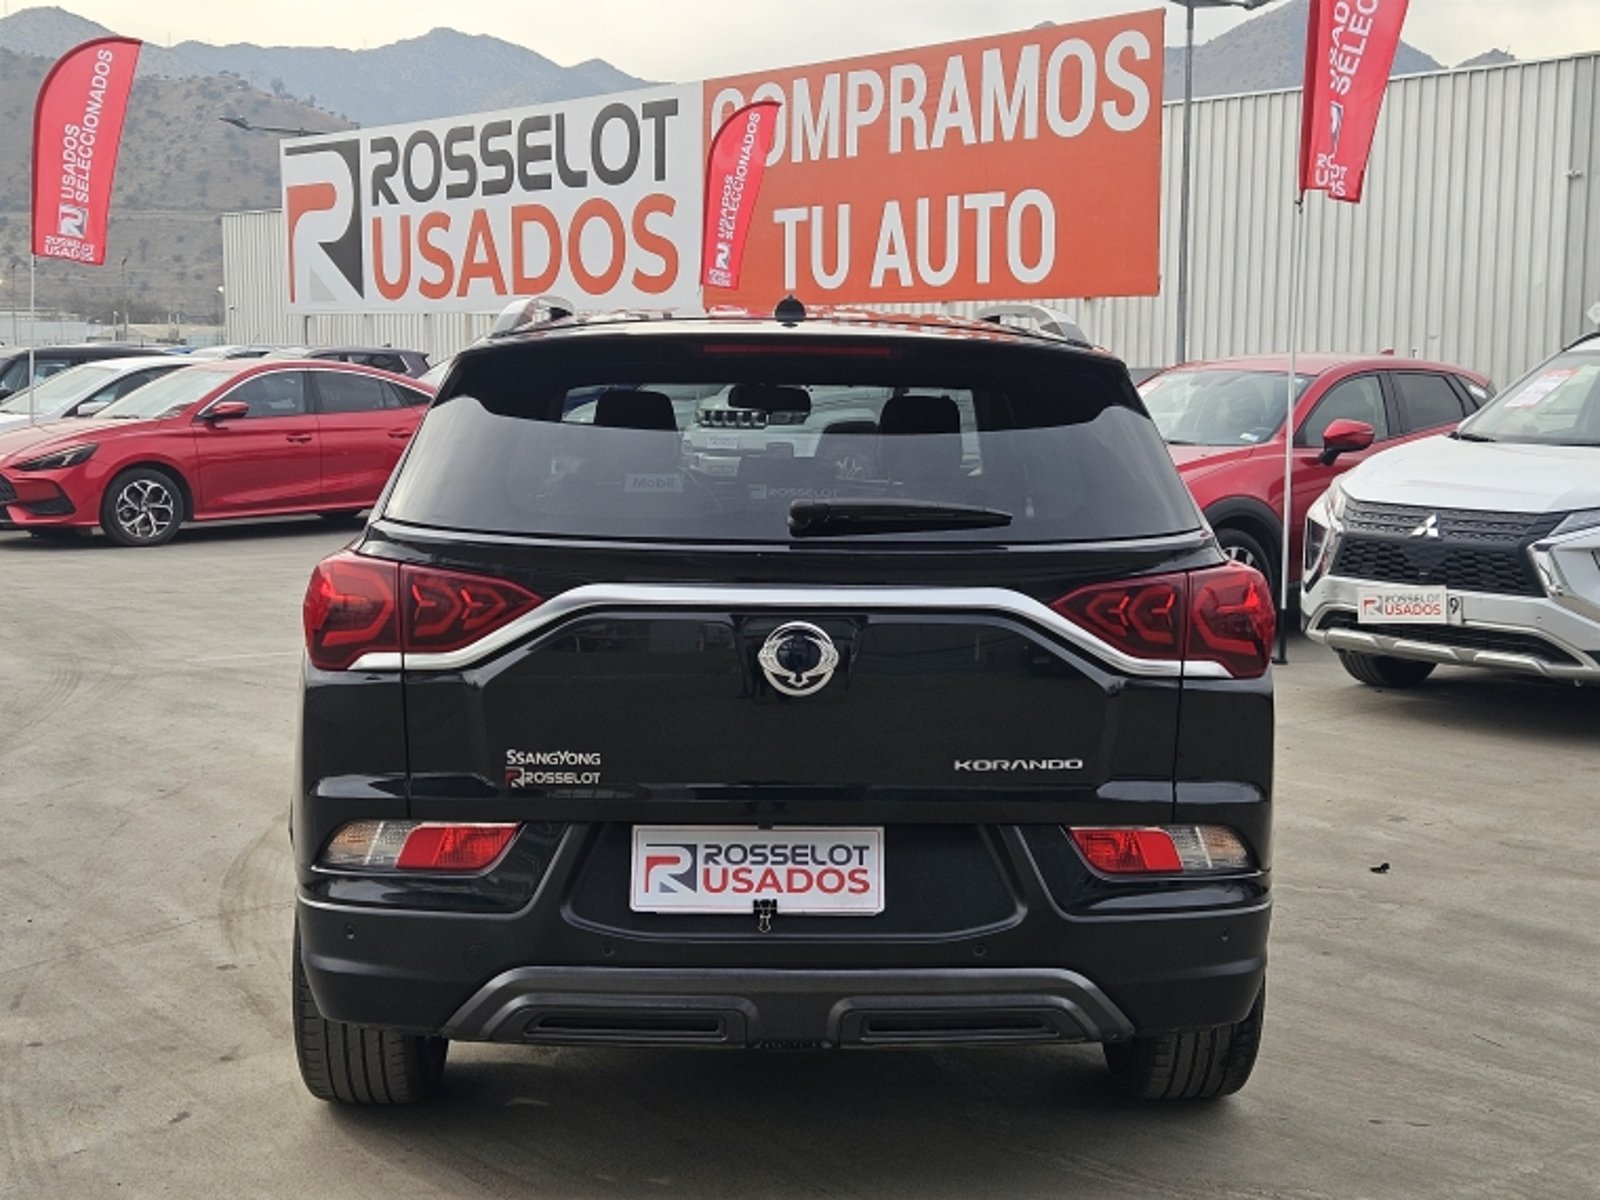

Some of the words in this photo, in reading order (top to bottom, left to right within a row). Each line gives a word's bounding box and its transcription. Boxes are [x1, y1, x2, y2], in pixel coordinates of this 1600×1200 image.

[75, 49, 114, 204] SELECCIONADOS
[370, 98, 679, 206] ROSSELOT
[60, 123, 81, 199] USADOS
[371, 193, 680, 300] USADOS
[773, 204, 851, 290] TU
[870, 189, 1056, 288] AUTO
[1384, 603, 1441, 616] USADOS
[524, 772, 601, 784] ROSSELOT
[953, 759, 1083, 771] KORANDO
[703, 844, 870, 866] ROSSELOT
[703, 867, 871, 894] USADOS
